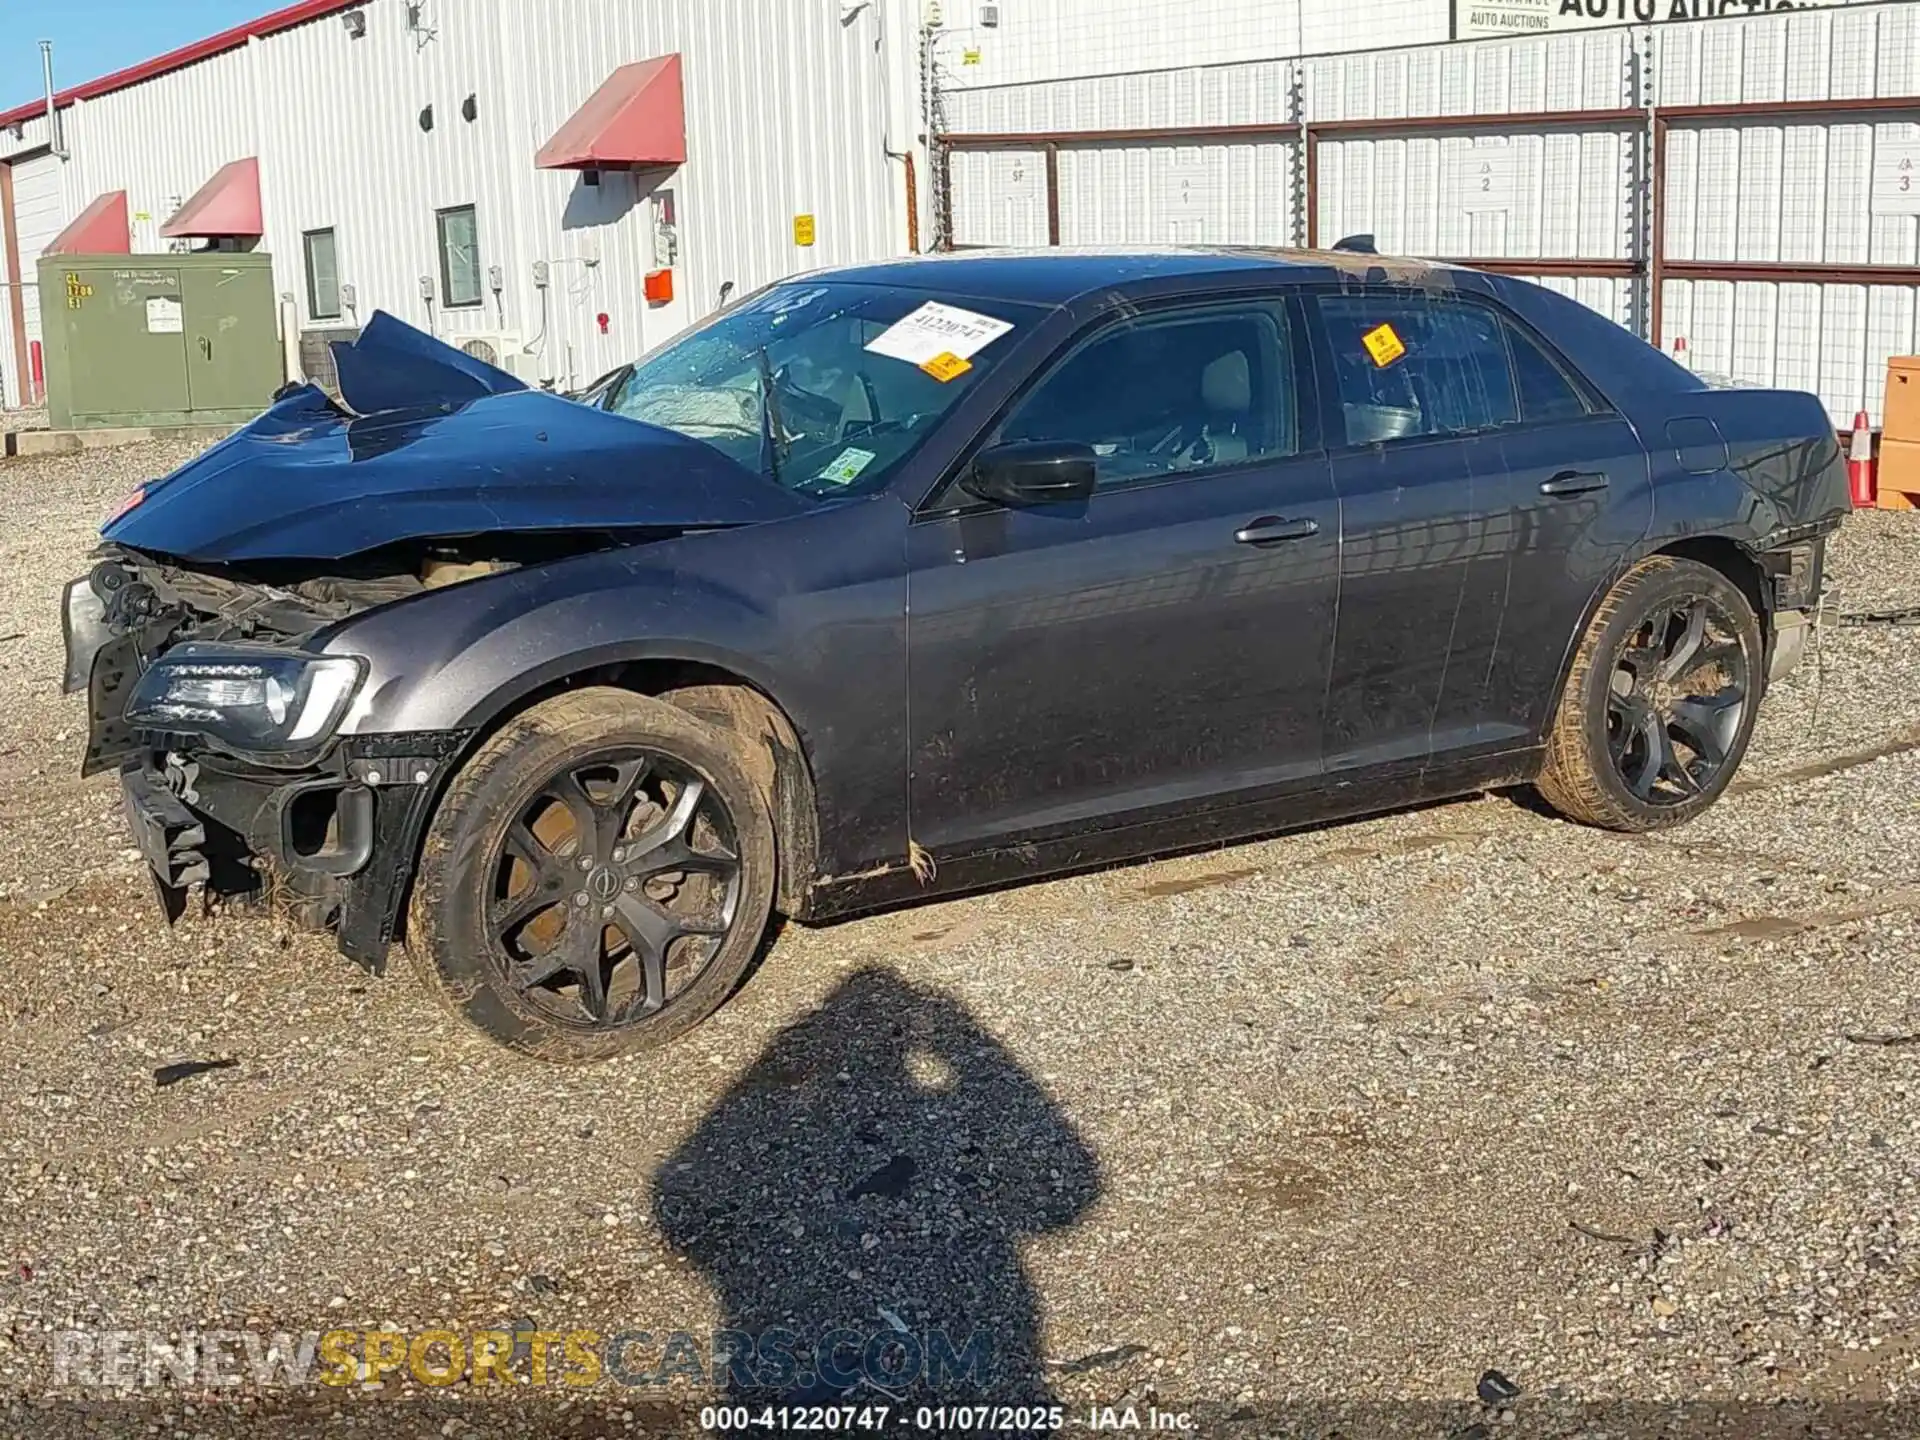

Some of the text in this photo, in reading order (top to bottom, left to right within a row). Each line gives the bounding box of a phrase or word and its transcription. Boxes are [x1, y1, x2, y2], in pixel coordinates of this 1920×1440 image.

[1558, 0, 1655, 21] AUTO
[1470, 11, 1549, 29] AUTO AUCTIONS
[1481, 178, 1490, 191] 2
[1899, 175, 1910, 191] 3
